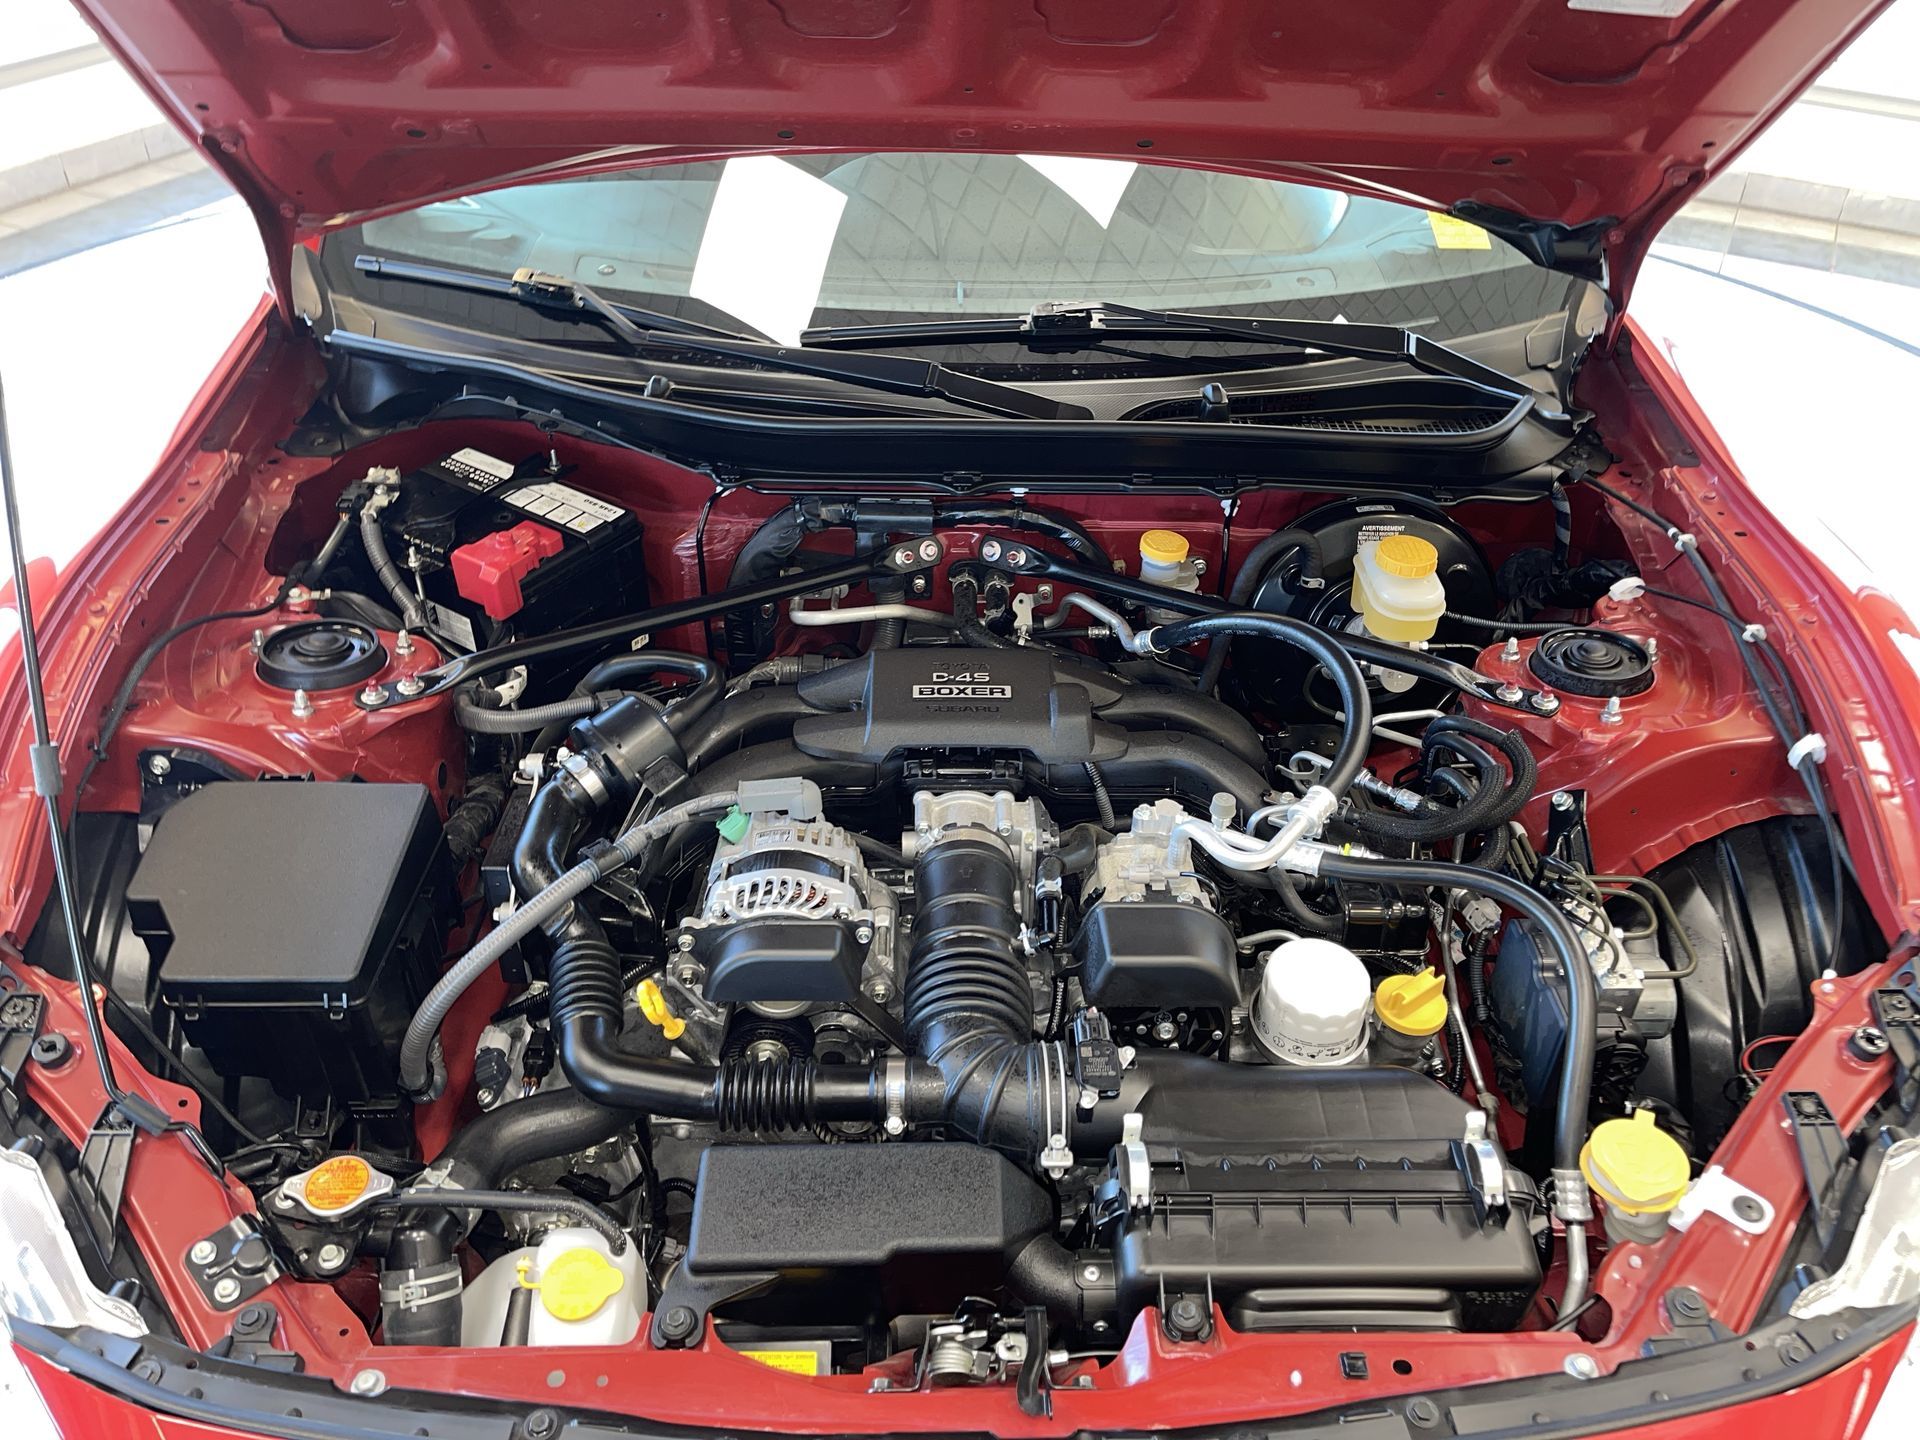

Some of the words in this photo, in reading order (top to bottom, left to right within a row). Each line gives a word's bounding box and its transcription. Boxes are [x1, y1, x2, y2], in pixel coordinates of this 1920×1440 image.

[932, 661, 991, 670] TOYOTA
[932, 672, 990, 683] D-4S
[918, 686, 1006, 696] BOXER
[926, 704, 1000, 713] SUBARU
